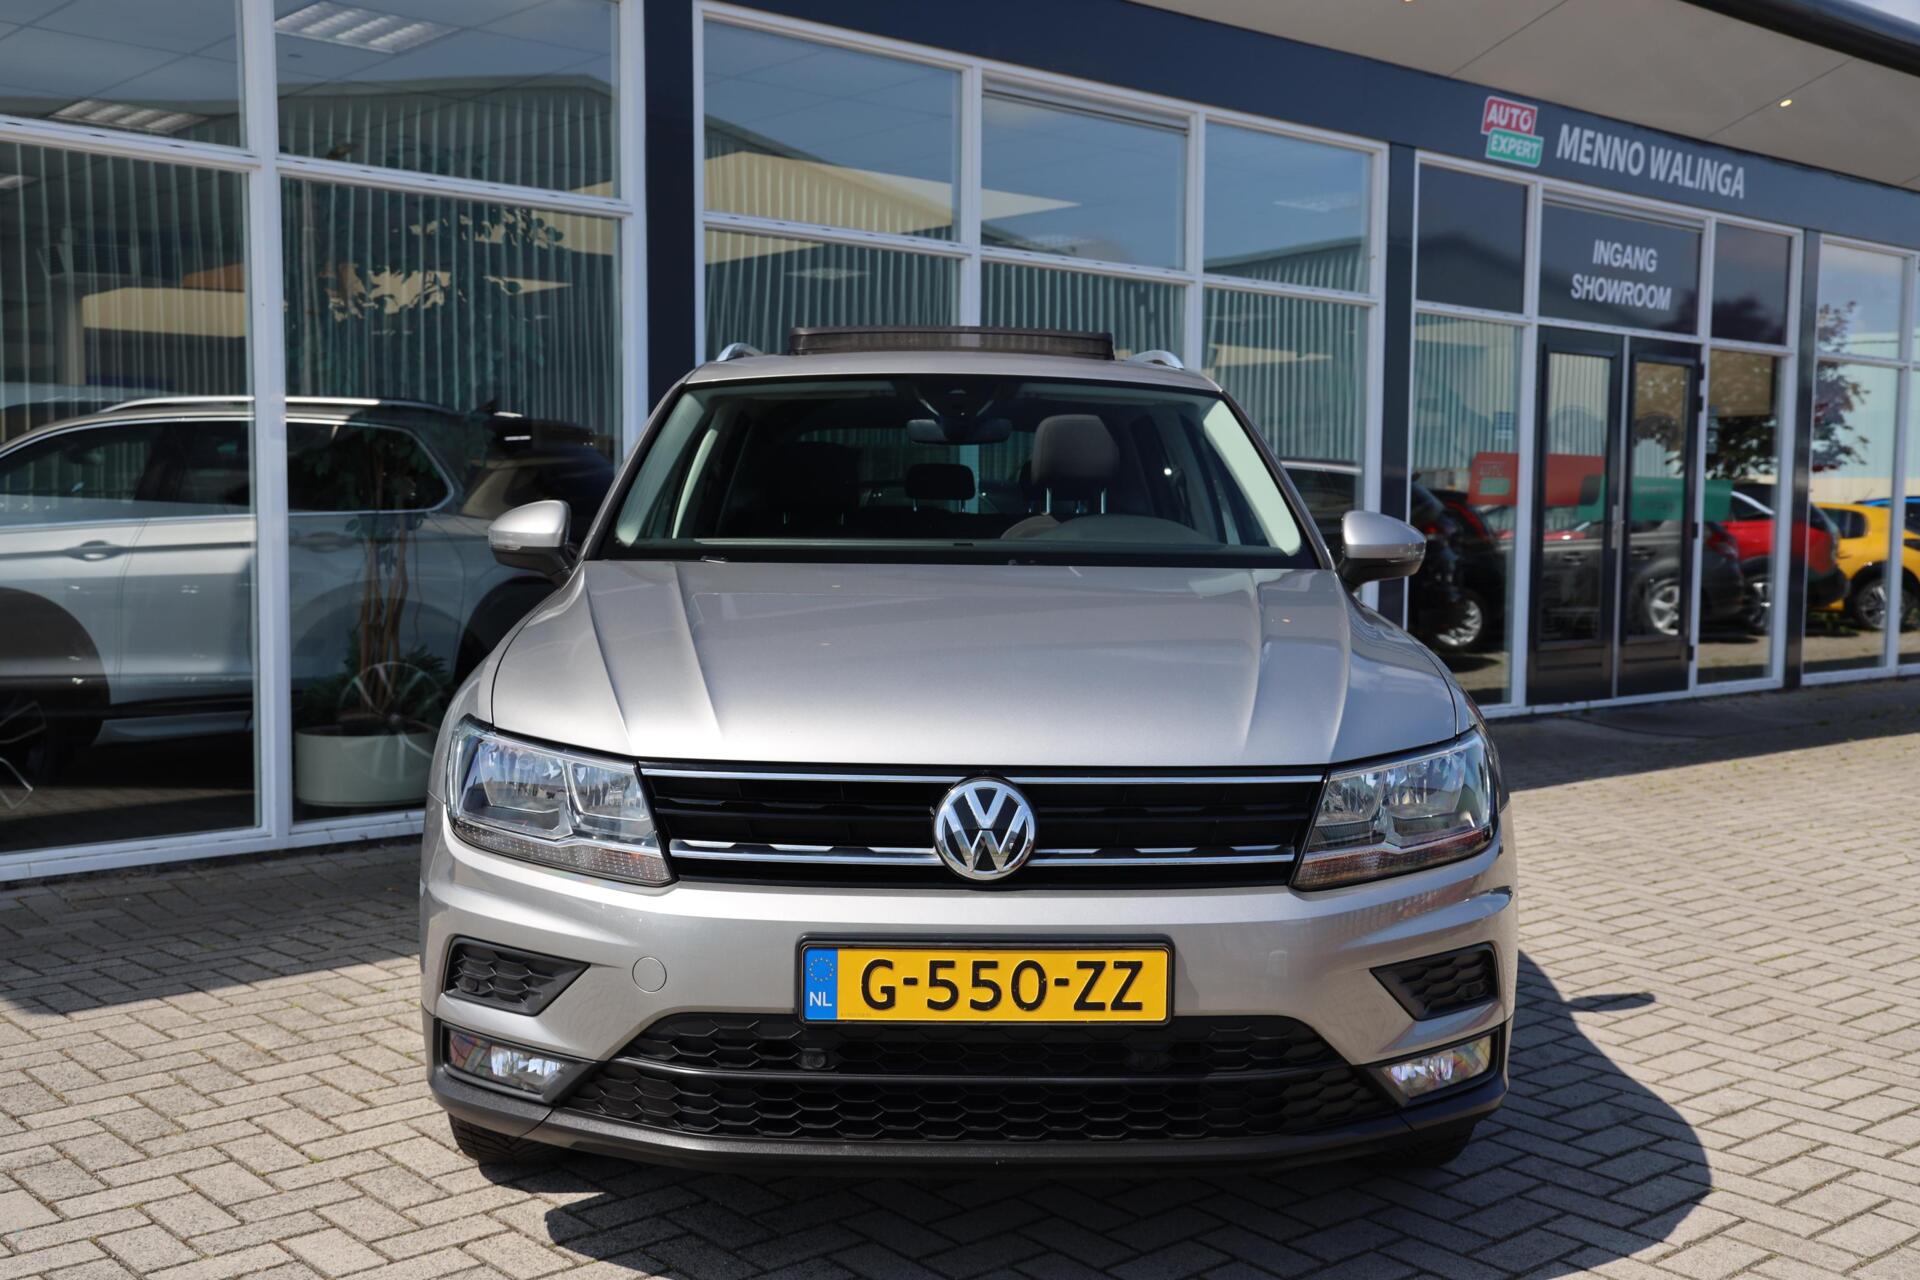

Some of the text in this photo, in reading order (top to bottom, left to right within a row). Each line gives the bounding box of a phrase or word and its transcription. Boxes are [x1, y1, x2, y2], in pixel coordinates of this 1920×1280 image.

[1486, 102, 1533, 131] AUTO
[1490, 133, 1540, 160] EXPERT
[1556, 123, 1745, 199] MENNO WALINGA
[1592, 239, 1658, 273] INGANG
[1571, 273, 1672, 311] SHOWROOM
[809, 991, 833, 1007] NL
[860, 957, 1144, 1012] G-550-ZZ
